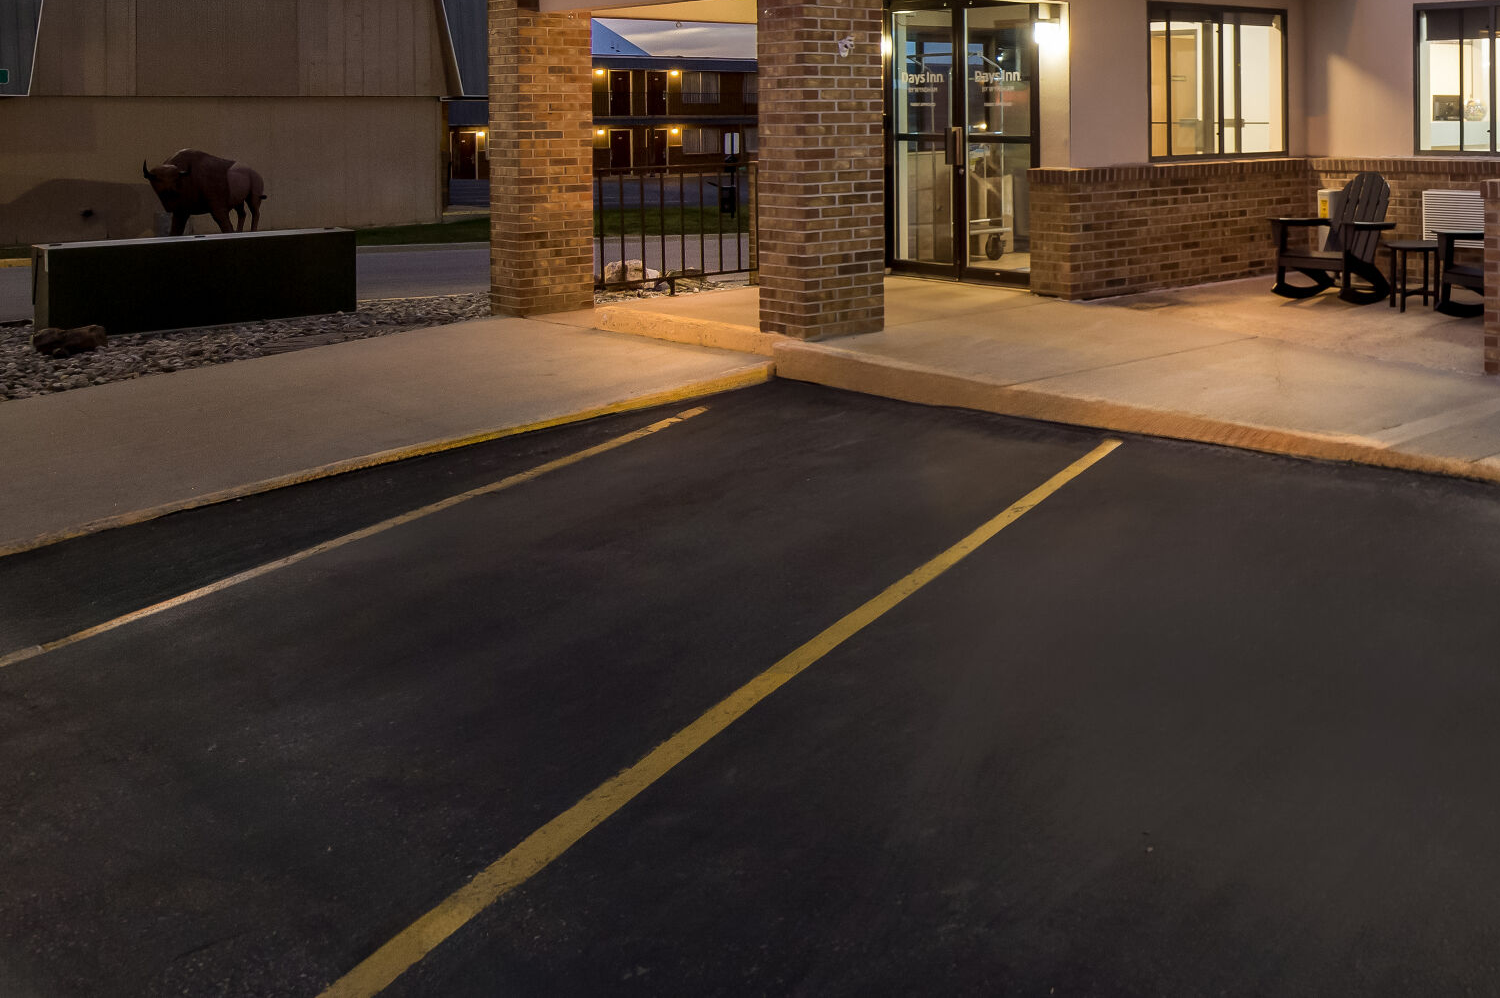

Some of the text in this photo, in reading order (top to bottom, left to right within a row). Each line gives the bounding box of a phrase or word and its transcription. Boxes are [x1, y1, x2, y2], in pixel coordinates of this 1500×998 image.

[901, 72, 944, 85] Days Inn
[1001, 69, 1021, 82] Inn
